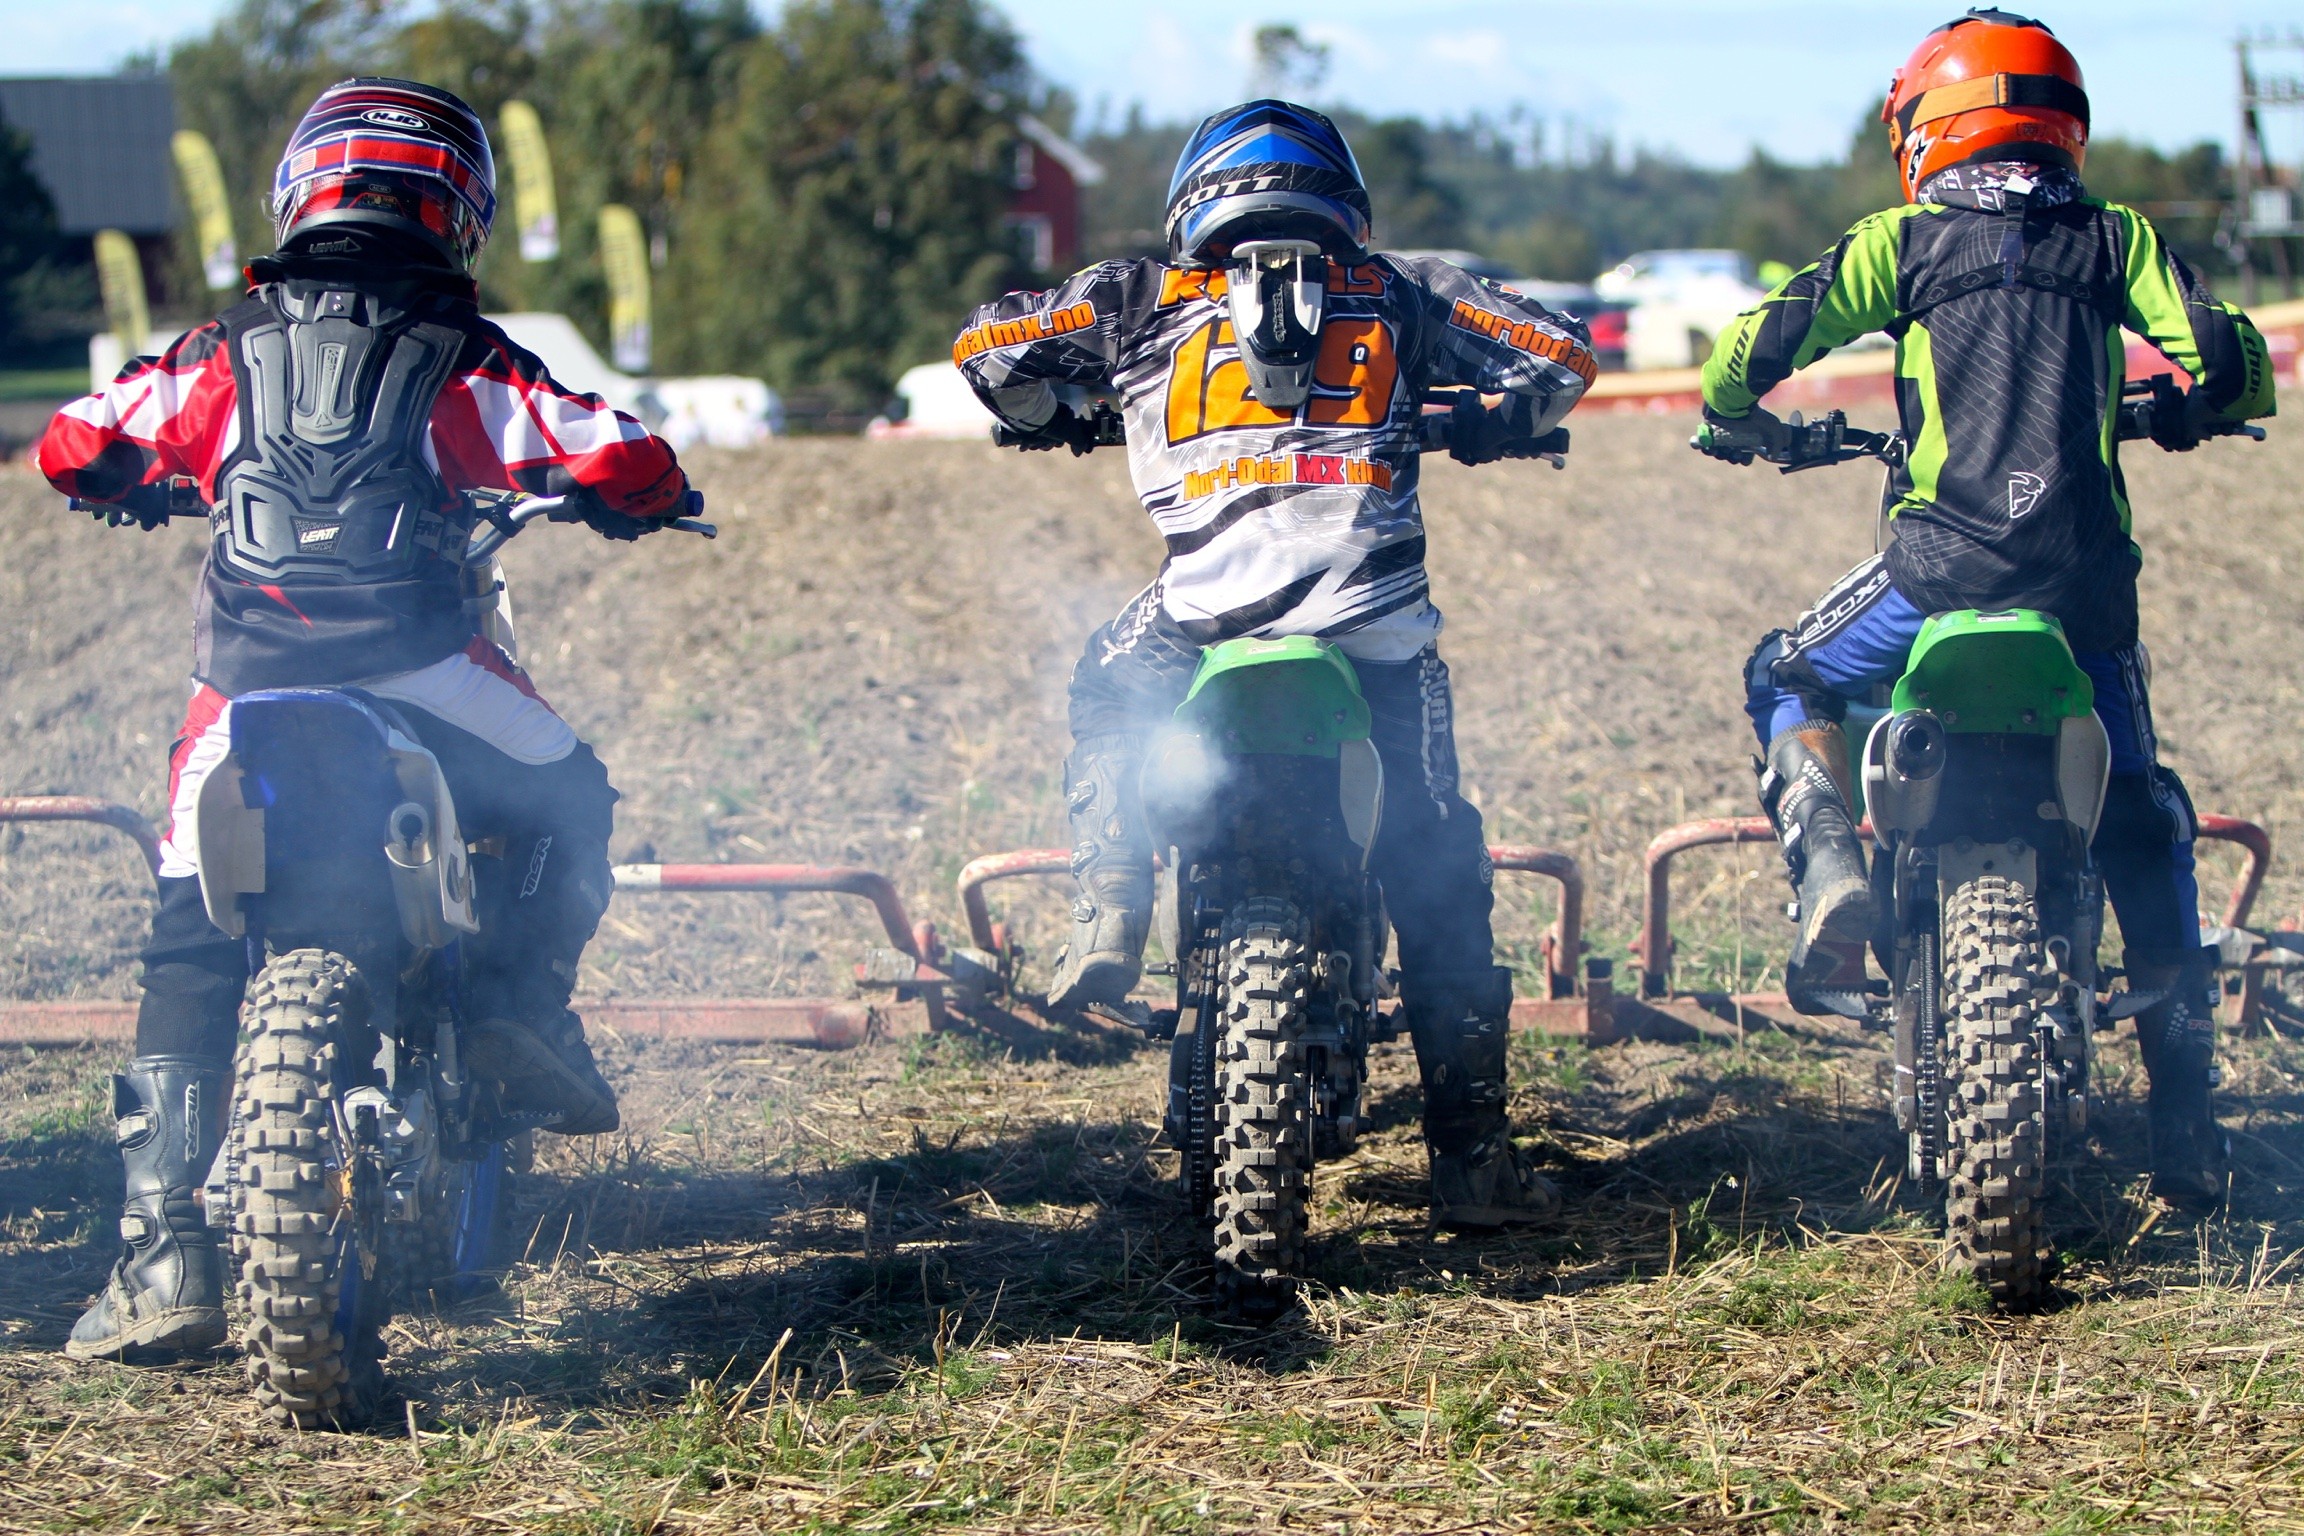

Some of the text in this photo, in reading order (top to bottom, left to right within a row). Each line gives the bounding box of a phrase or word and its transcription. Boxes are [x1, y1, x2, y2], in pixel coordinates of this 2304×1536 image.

[371, 111, 419, 126] HJC
[1165, 175, 1283, 243] SCOTT
[952, 301, 1094, 370] dalmx.no
[1726, 319, 1751, 388] thor
[2242, 335, 2262, 400] thor
[1167, 314, 1398, 449] 129
[1183, 454, 1294, 502] Nord-Odal
[1295, 454, 1345, 485] MX
[300, 526, 340, 544] LEATT
[185, 1080, 200, 1164] MSR
